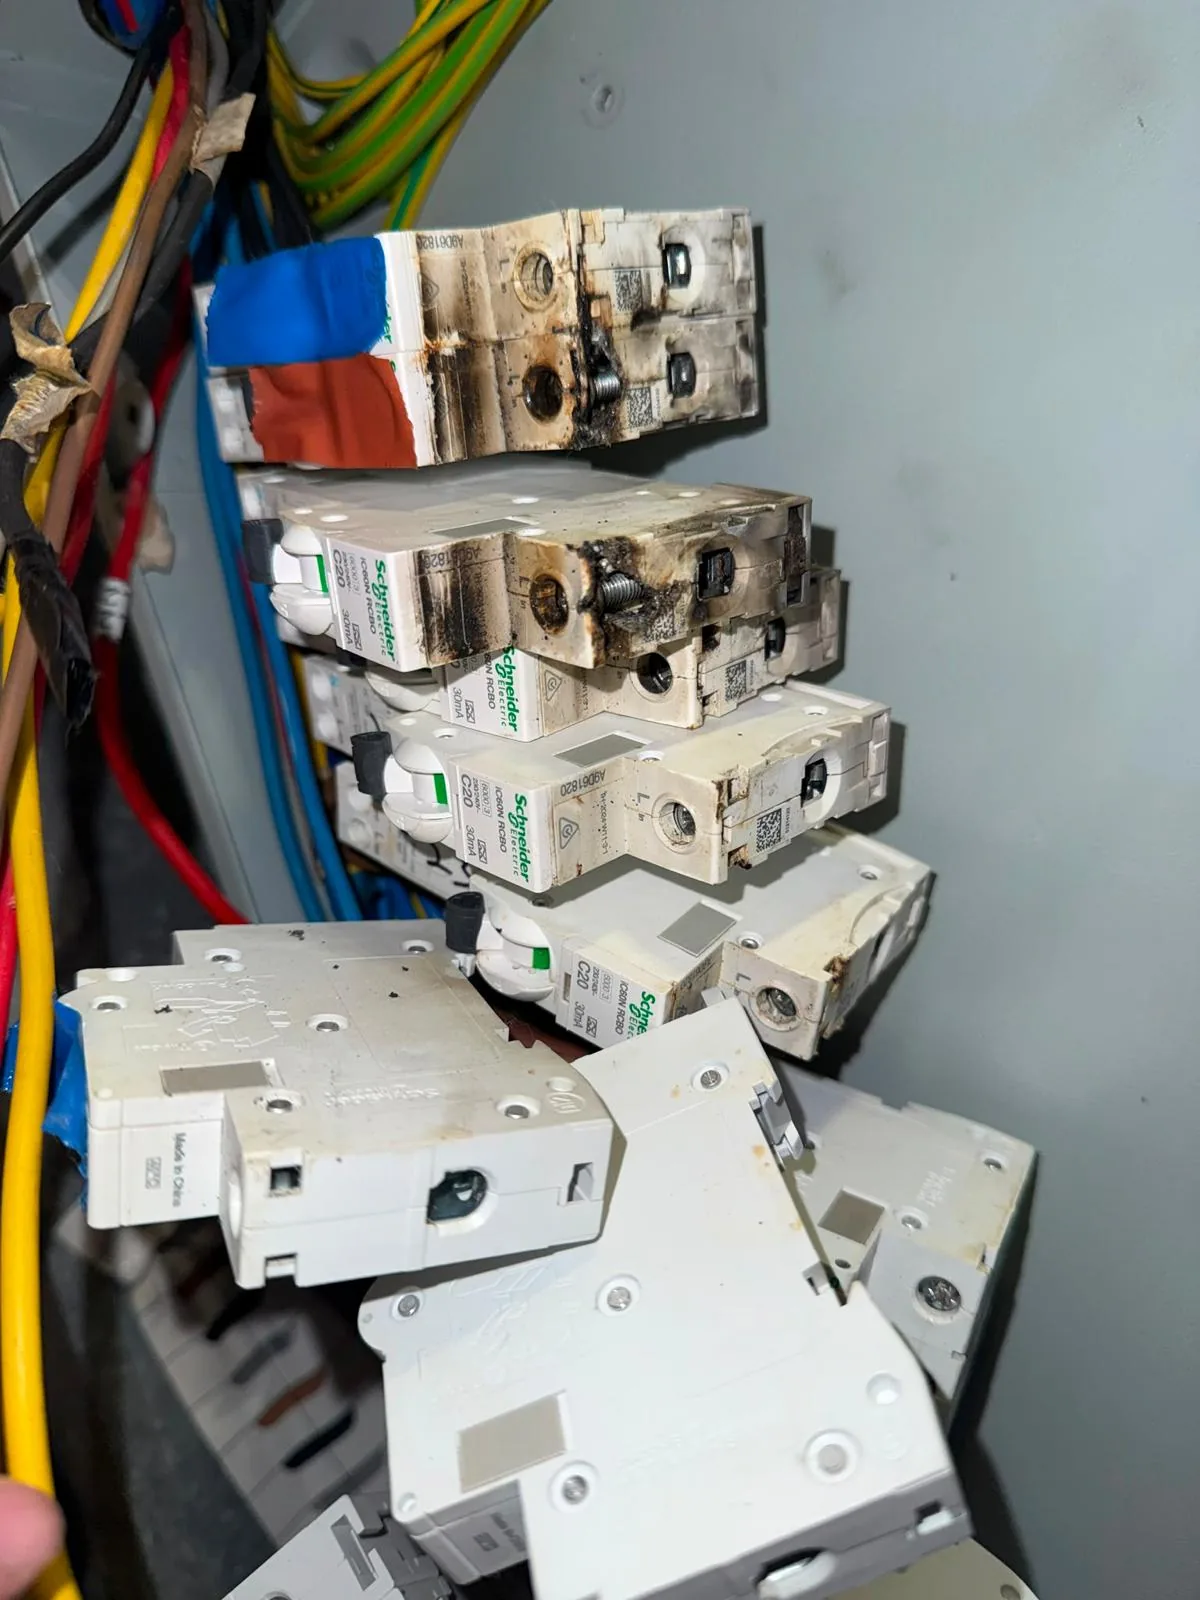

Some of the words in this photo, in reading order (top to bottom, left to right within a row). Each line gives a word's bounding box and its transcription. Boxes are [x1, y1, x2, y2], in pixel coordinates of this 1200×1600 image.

[333, 549, 346, 588] C20
[342, 609, 354, 644] 30mA
[366, 597, 376, 635] RCBO
[376, 559, 396, 662] Schneider
[375, 601, 386, 656] Electric
[453, 687, 464, 718] 30mA
[486, 676, 496, 710] RCBO
[497, 680, 507, 727] Electric
[503, 645, 520, 732] Schneider
[461, 774, 474, 808] C20
[560, 768, 606, 797] A9D61820
[466, 825, 477, 856] 30mA
[498, 820, 507, 853] RCBO
[510, 829, 519, 876] Electric
[514, 793, 531, 882] Schneider
[576, 960, 591, 990] C20
[573, 1001, 586, 1028] 30mA
[615, 1005, 627, 1035] RCBO
[627, 1015, 638, 1039] Elec
[636, 991, 656, 1035] Schne
